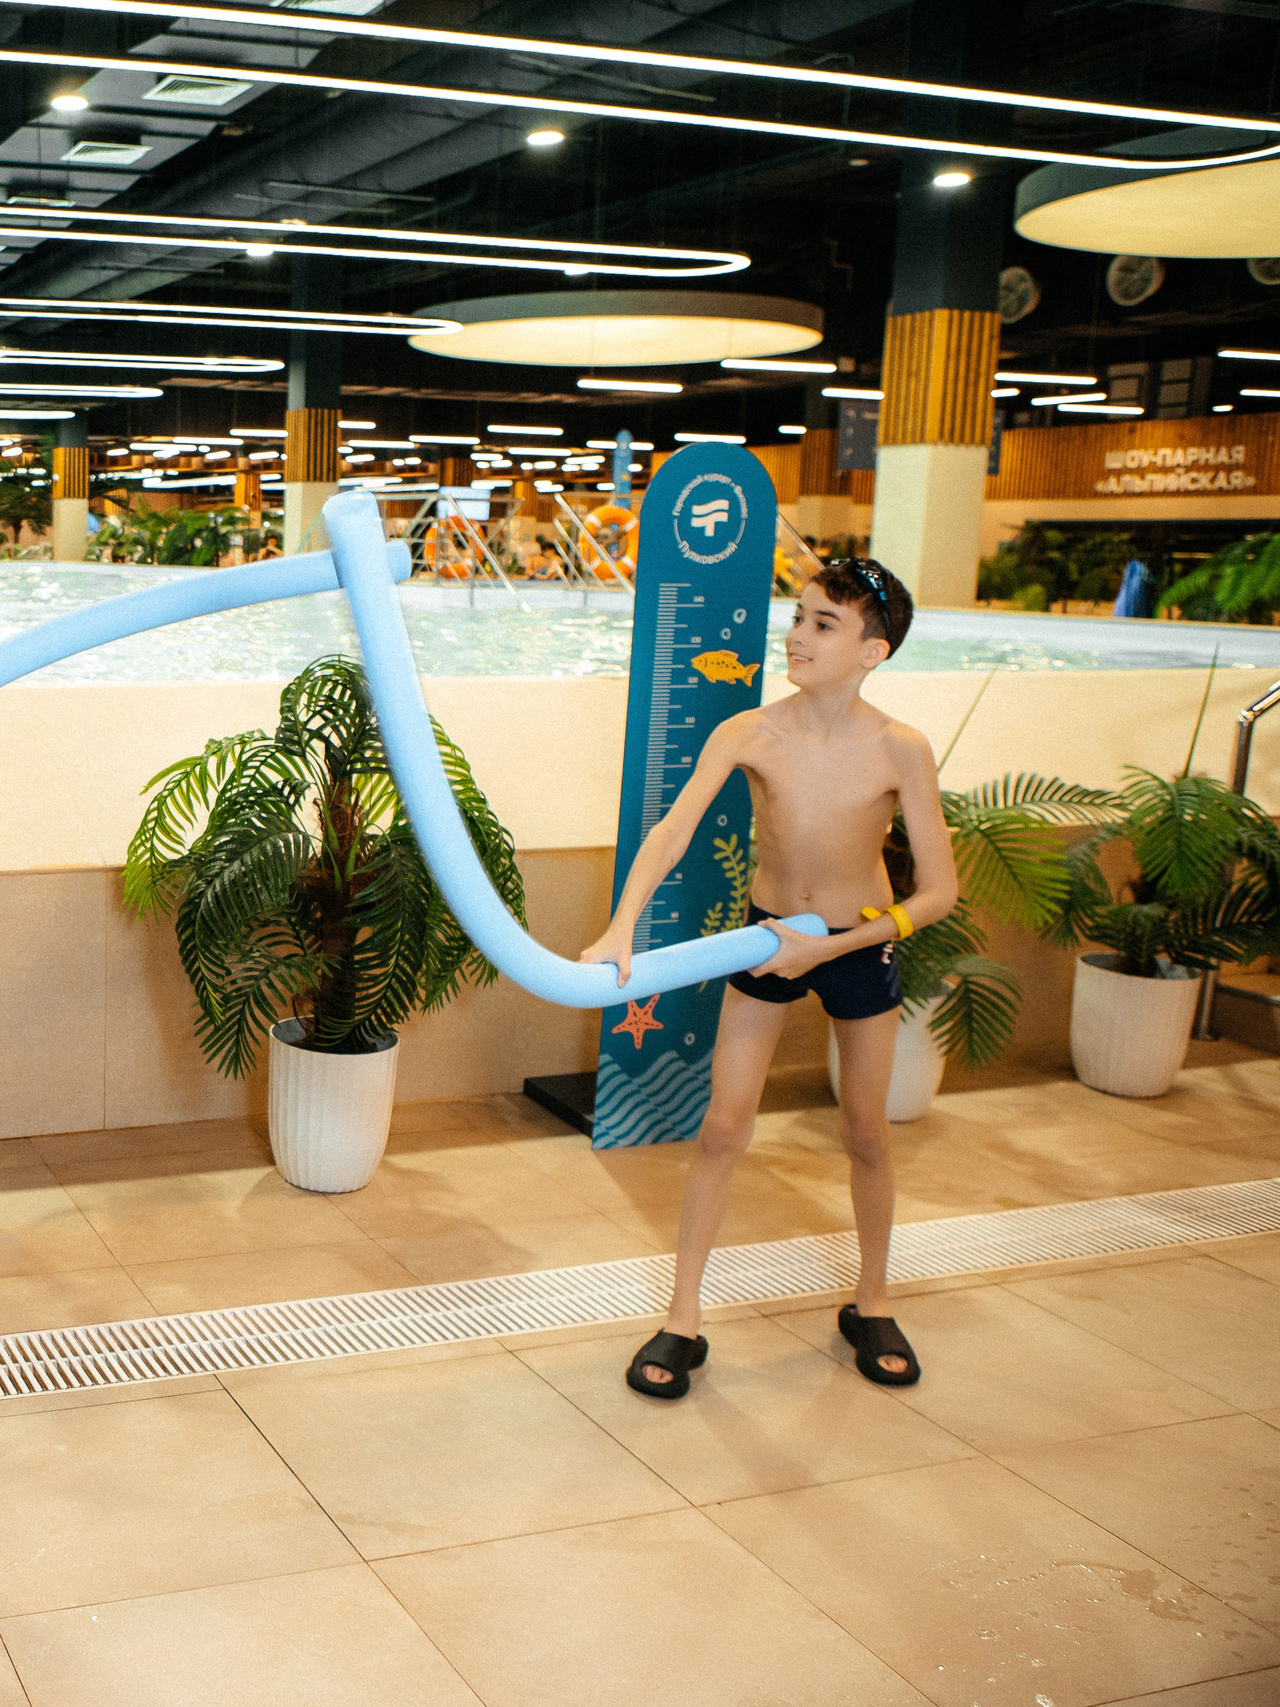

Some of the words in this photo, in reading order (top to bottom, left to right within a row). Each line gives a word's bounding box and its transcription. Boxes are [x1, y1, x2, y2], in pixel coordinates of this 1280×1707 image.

[1104, 445, 1245, 470] ШОУ-ПАРНАЯ
[672, 475, 703, 516] Городской
[703, 473, 732, 485] курорт
[678, 540, 738, 564] Пулковский
